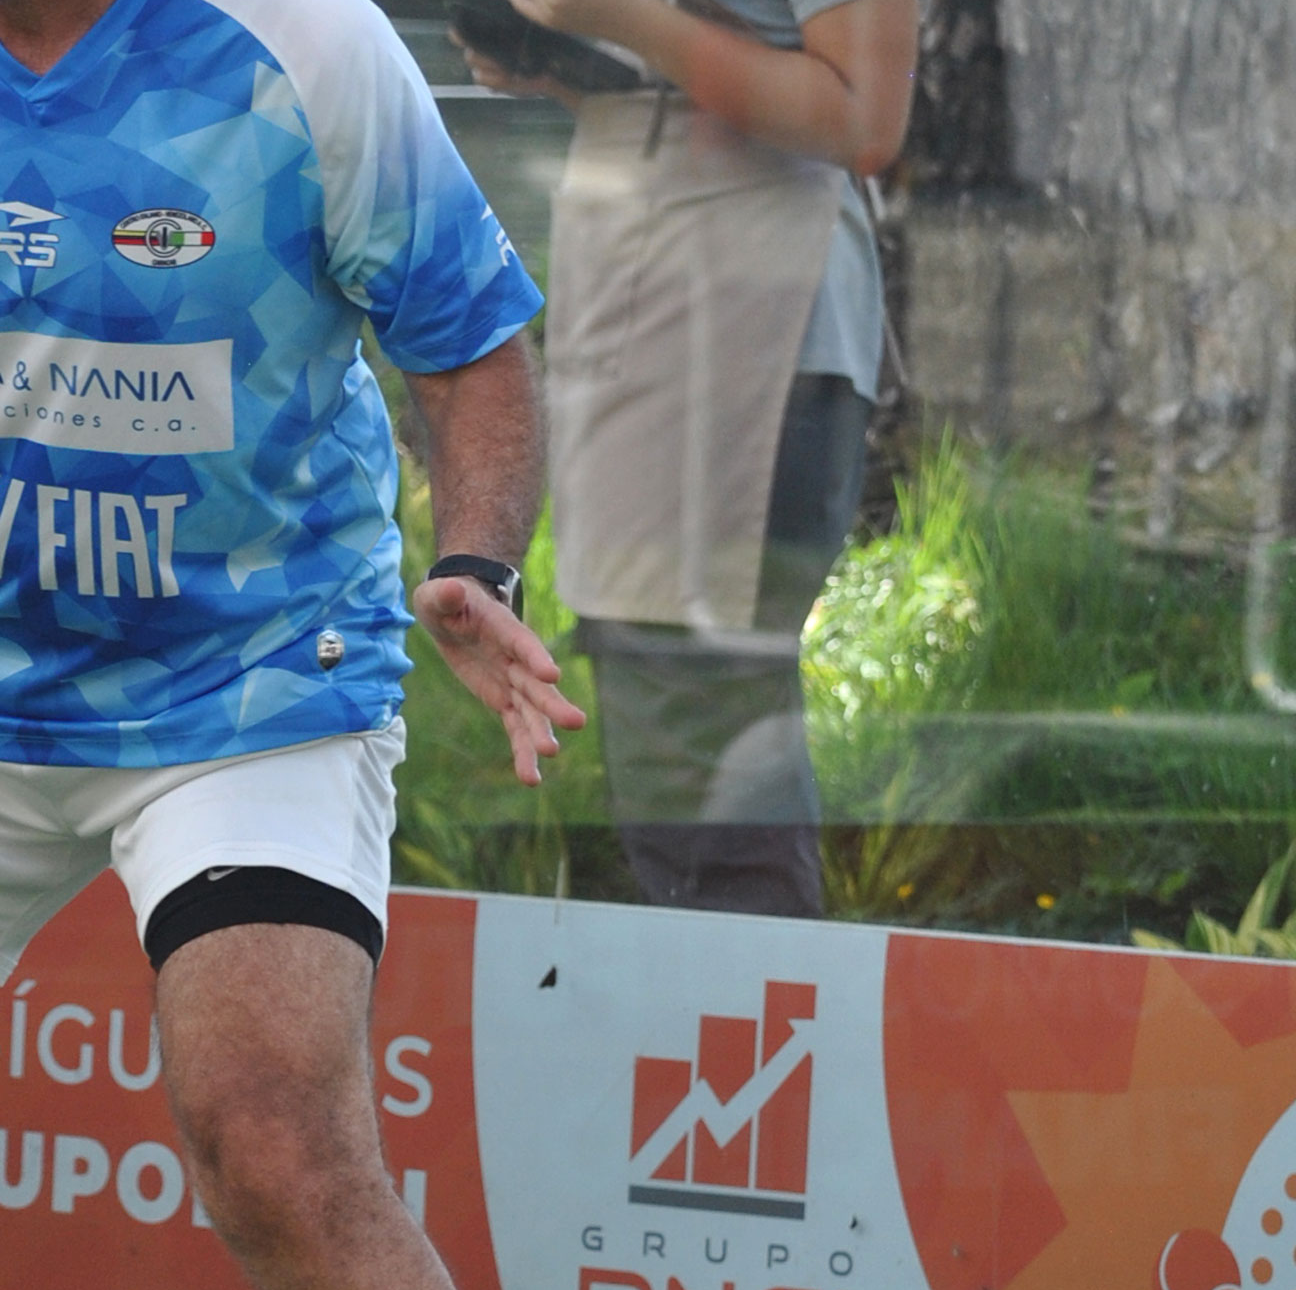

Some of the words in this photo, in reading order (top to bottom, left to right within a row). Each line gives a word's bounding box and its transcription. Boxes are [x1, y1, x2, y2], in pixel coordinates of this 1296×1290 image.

[12, 360, 32, 392] &
[49, 362, 196, 403] NANIA
[131, 416, 197, 432] c.a.
[37, 483, 188, 599] FIAT
[582, 1225, 853, 1277] GRUPO
